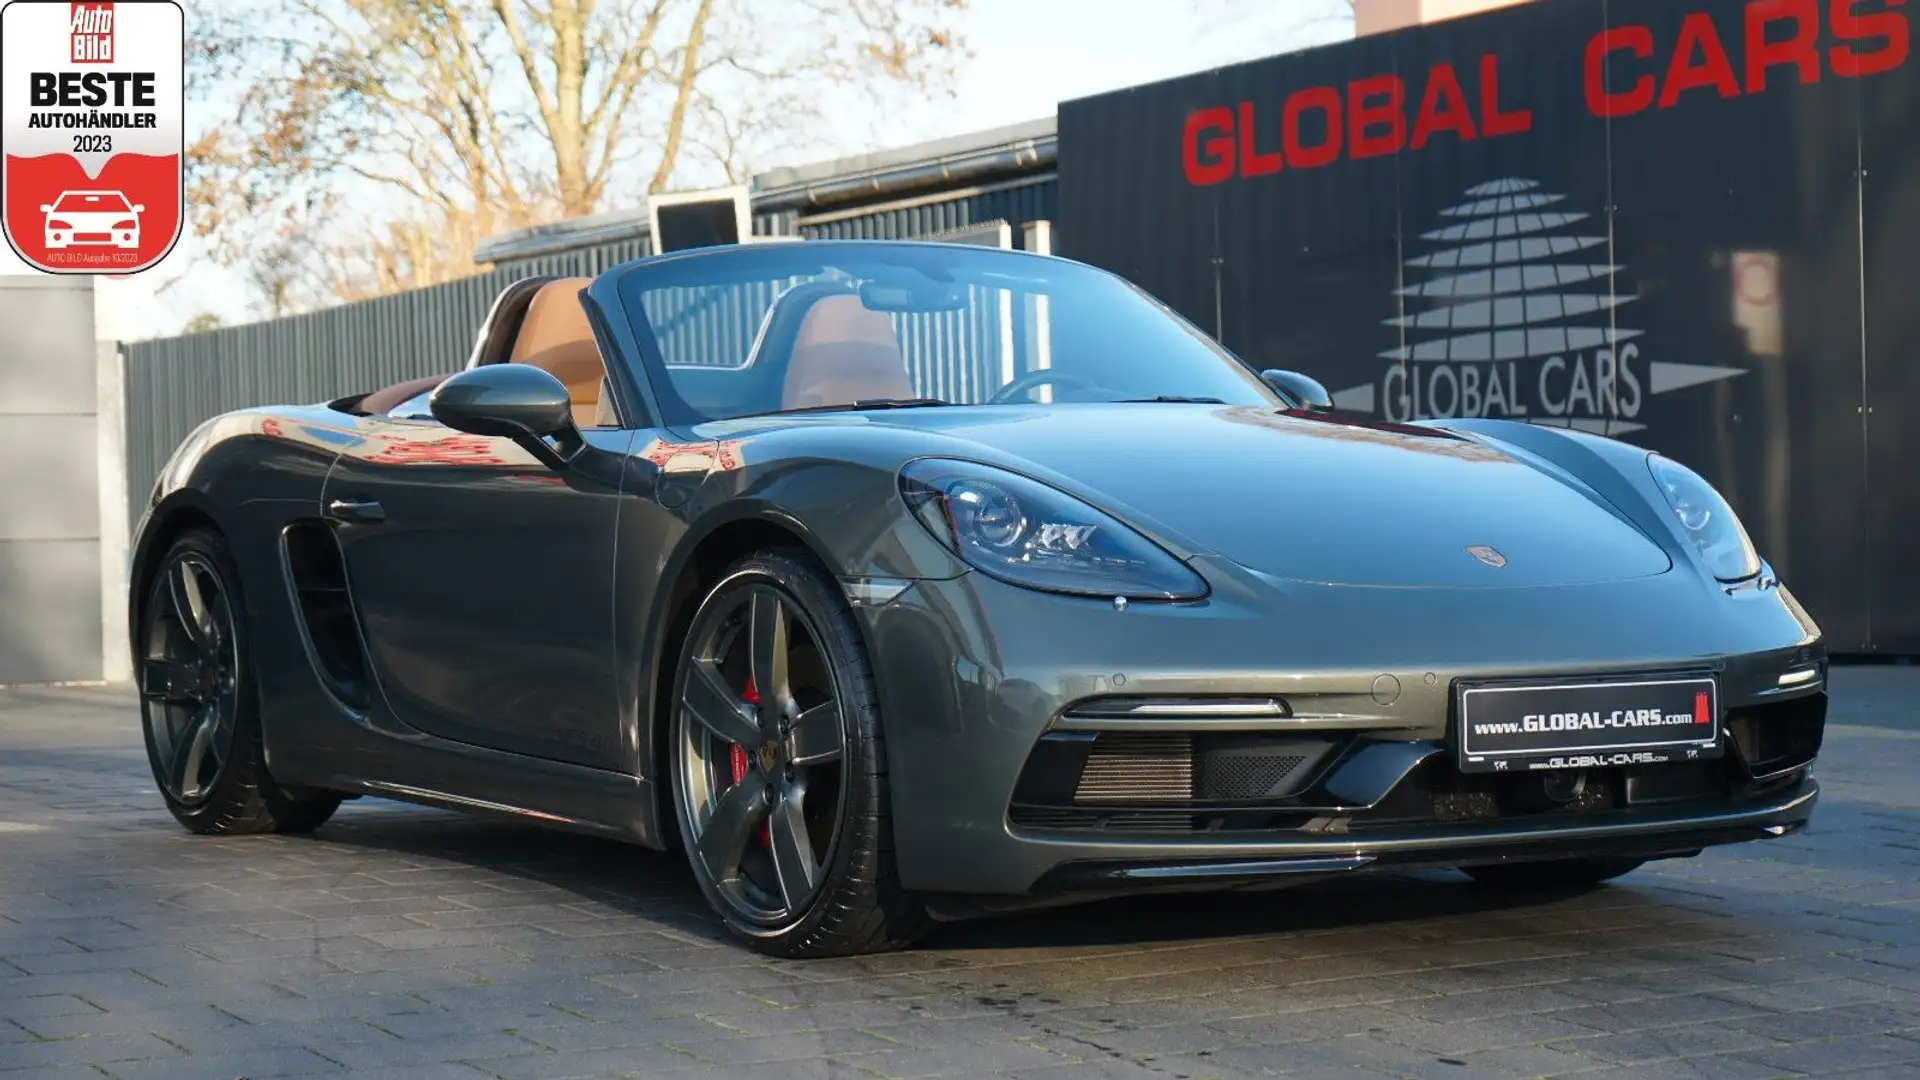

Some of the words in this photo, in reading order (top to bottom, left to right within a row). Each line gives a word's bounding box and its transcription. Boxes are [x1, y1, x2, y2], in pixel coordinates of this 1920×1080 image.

[1182, 53, 1531, 186] GLOBAL
[1583, 0, 1909, 118] CARS
[1384, 362, 1527, 424] GLOBAL
[1539, 342, 1641, 417] CARS
[1475, 709, 1692, 734] www.GLOBAL-CARS.com
